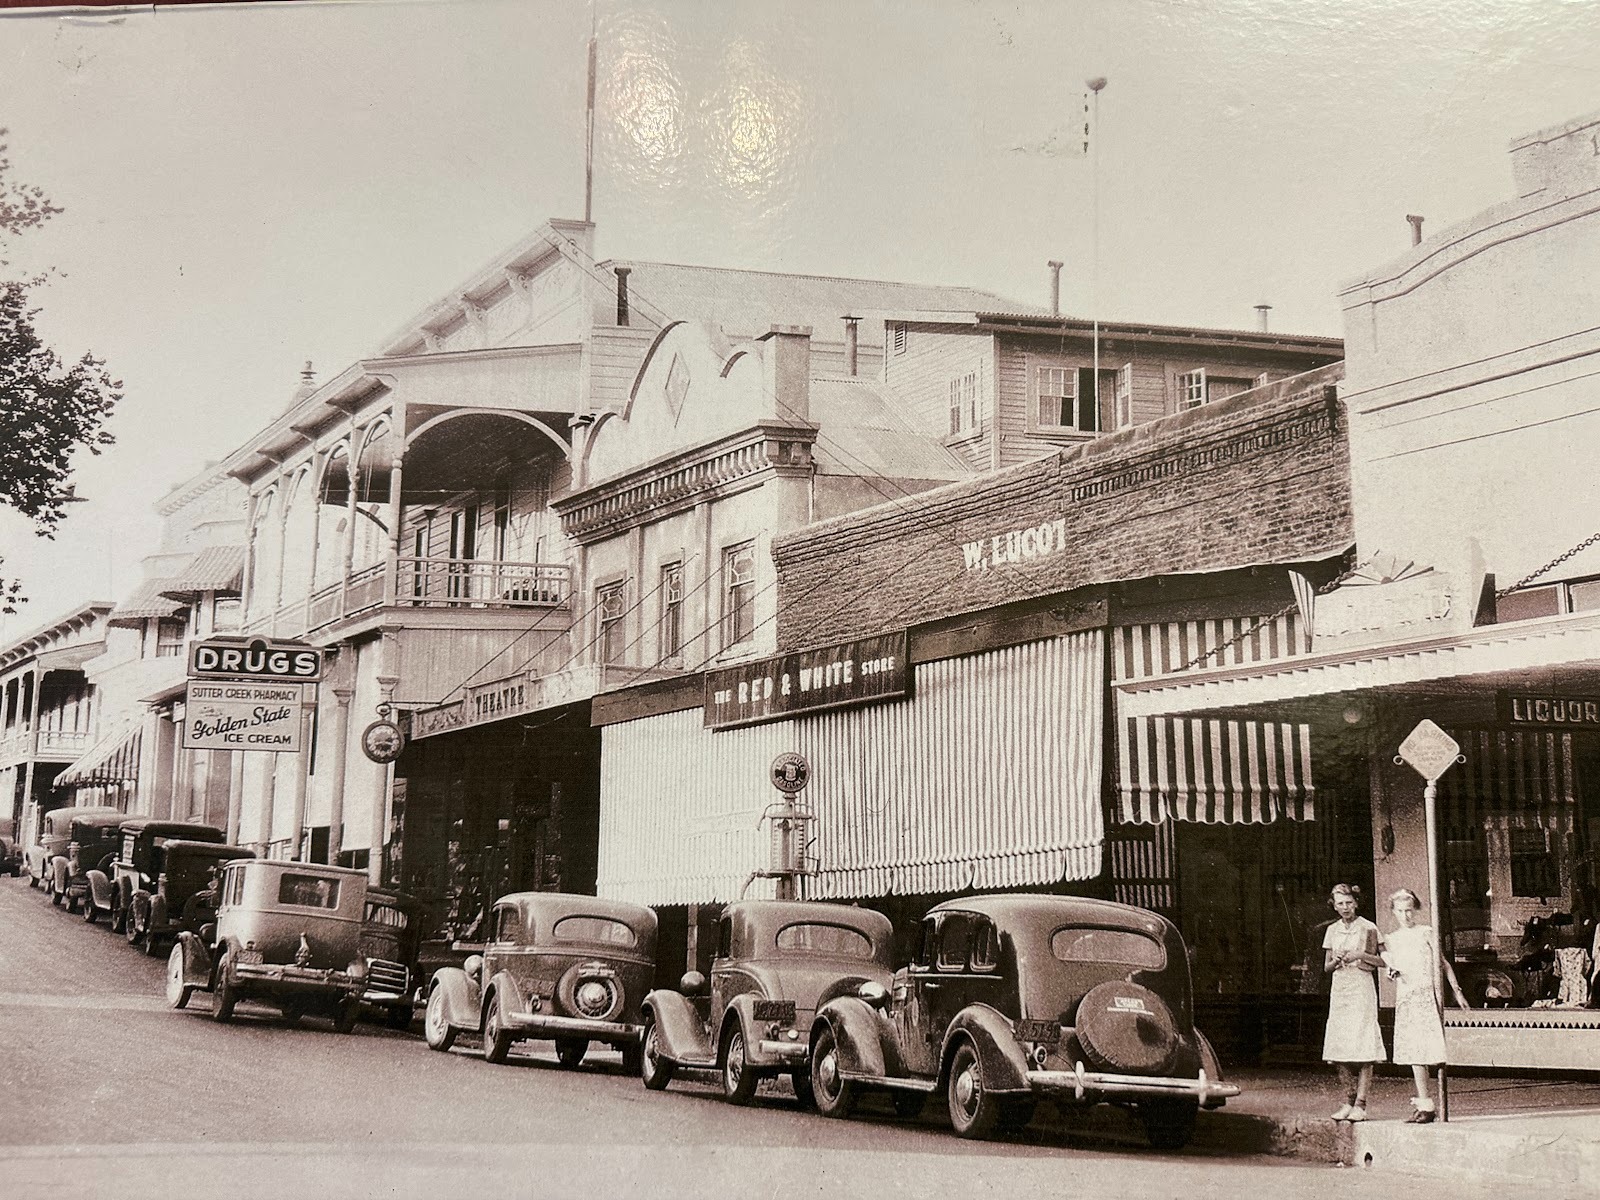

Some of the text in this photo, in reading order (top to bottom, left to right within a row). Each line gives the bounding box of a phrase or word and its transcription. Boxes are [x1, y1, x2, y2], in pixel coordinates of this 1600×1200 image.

[198, 648, 316, 675] DRUGS
[714, 656, 896, 704] THE RED & WHITE STORE
[192, 687, 298, 701] SUTTER CREEK PHARMACY
[475, 684, 525, 716] THEATRE
[191, 705, 291, 740] Golden State
[1512, 698, 1600, 723] LIQUOR
[223, 733, 292, 744] ICE CREAM
